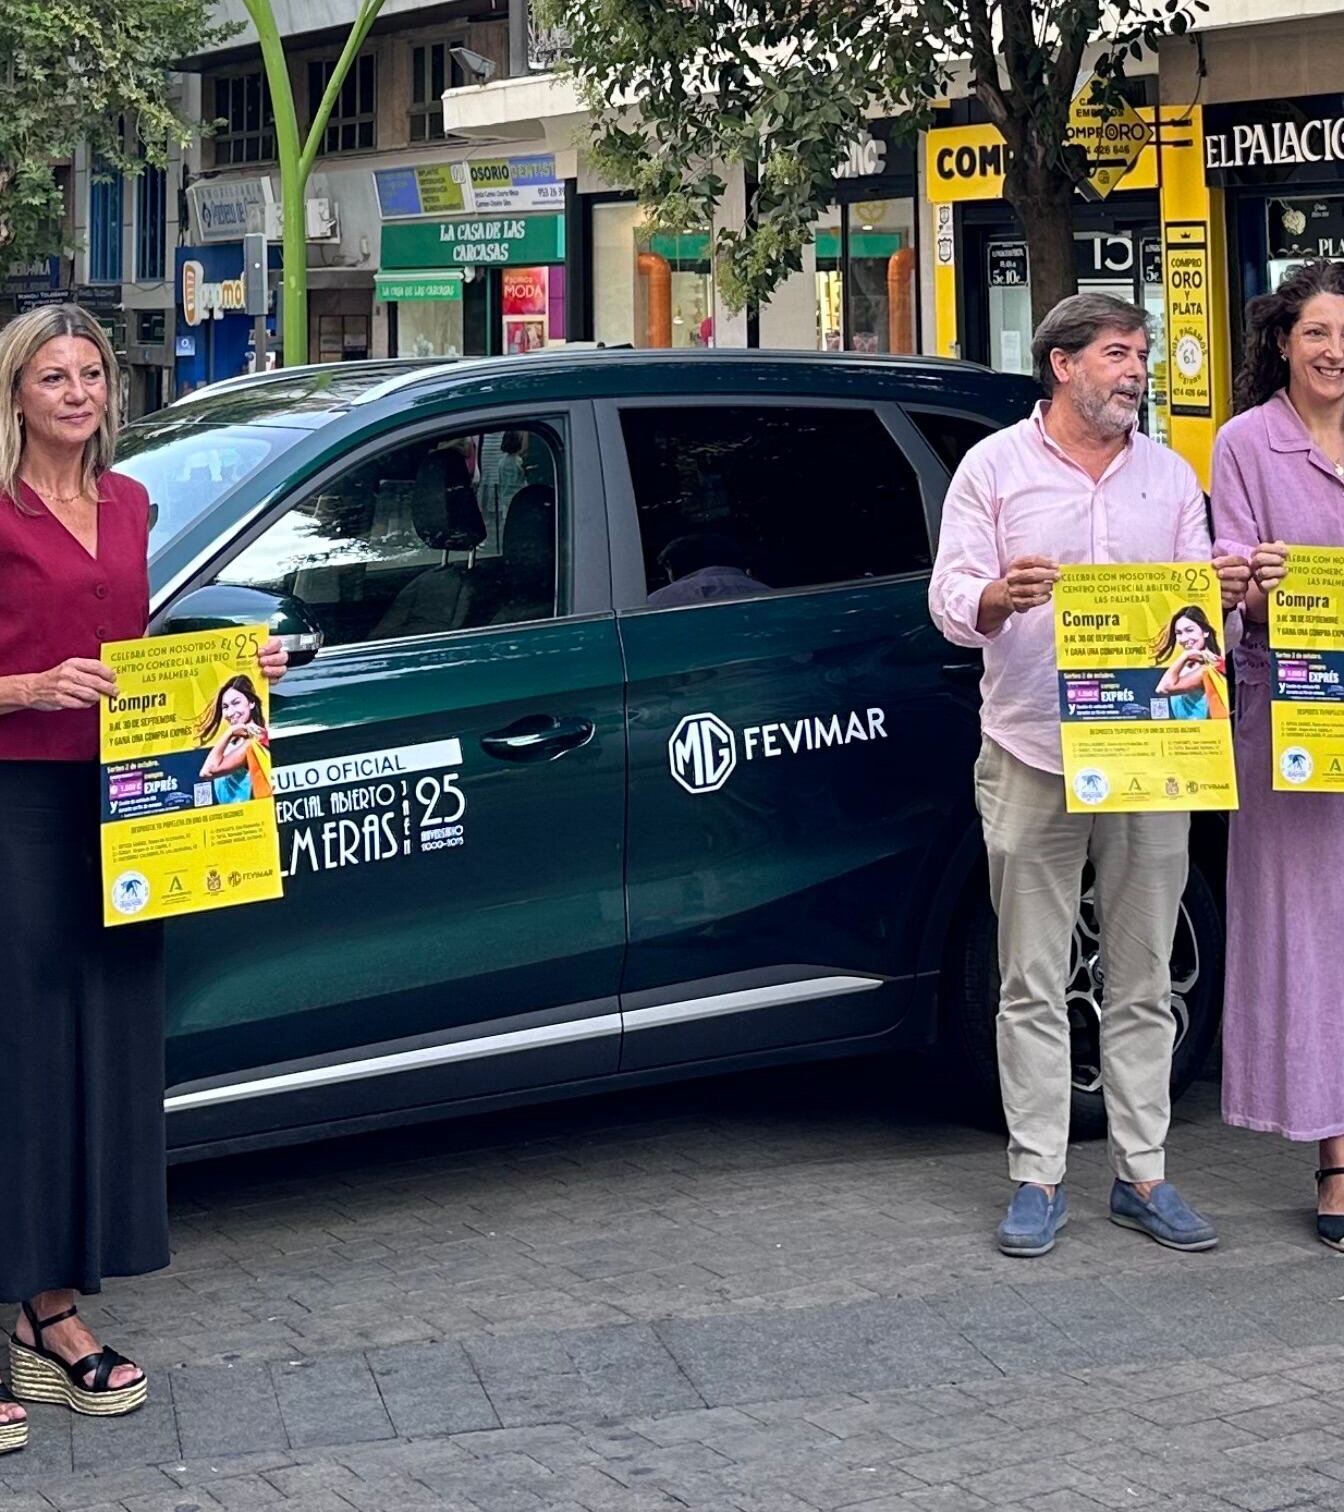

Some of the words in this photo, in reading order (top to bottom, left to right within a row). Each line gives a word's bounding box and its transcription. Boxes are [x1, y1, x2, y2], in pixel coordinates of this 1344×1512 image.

[1206, 135, 1235, 168] EL
[471, 165, 509, 181] OSORIO
[440, 224, 454, 241] LA
[458, 223, 484, 240] CASA
[486, 222, 501, 239] DE
[503, 220, 525, 238] LAS
[453, 243, 508, 261] CARCASAS
[1171, 258, 1202, 267] COMPRO
[1172, 272, 1202, 288] ORO
[504, 285, 543, 298] MODA
[1185, 291, 1189, 300] Y
[1173, 304, 1202, 315] PLATA
[1184, 569, 1210, 592] 25
[1276, 591, 1329, 610] Compra
[1062, 611, 1120, 629] Compra
[235, 633, 258, 659] 25
[1308, 669, 1340, 682] EXPRÉS
[108, 693, 166, 713] Compra
[1101, 688, 1134, 701] EXPRÉS
[675, 720, 730, 786] MG
[744, 707, 888, 760] FEVIMAR
[326, 754, 407, 781] OFICIAL
[143, 774, 178, 794] EXPRÉS
[331, 783, 395, 815] ABIERTO
[416, 773, 465, 827] 25
